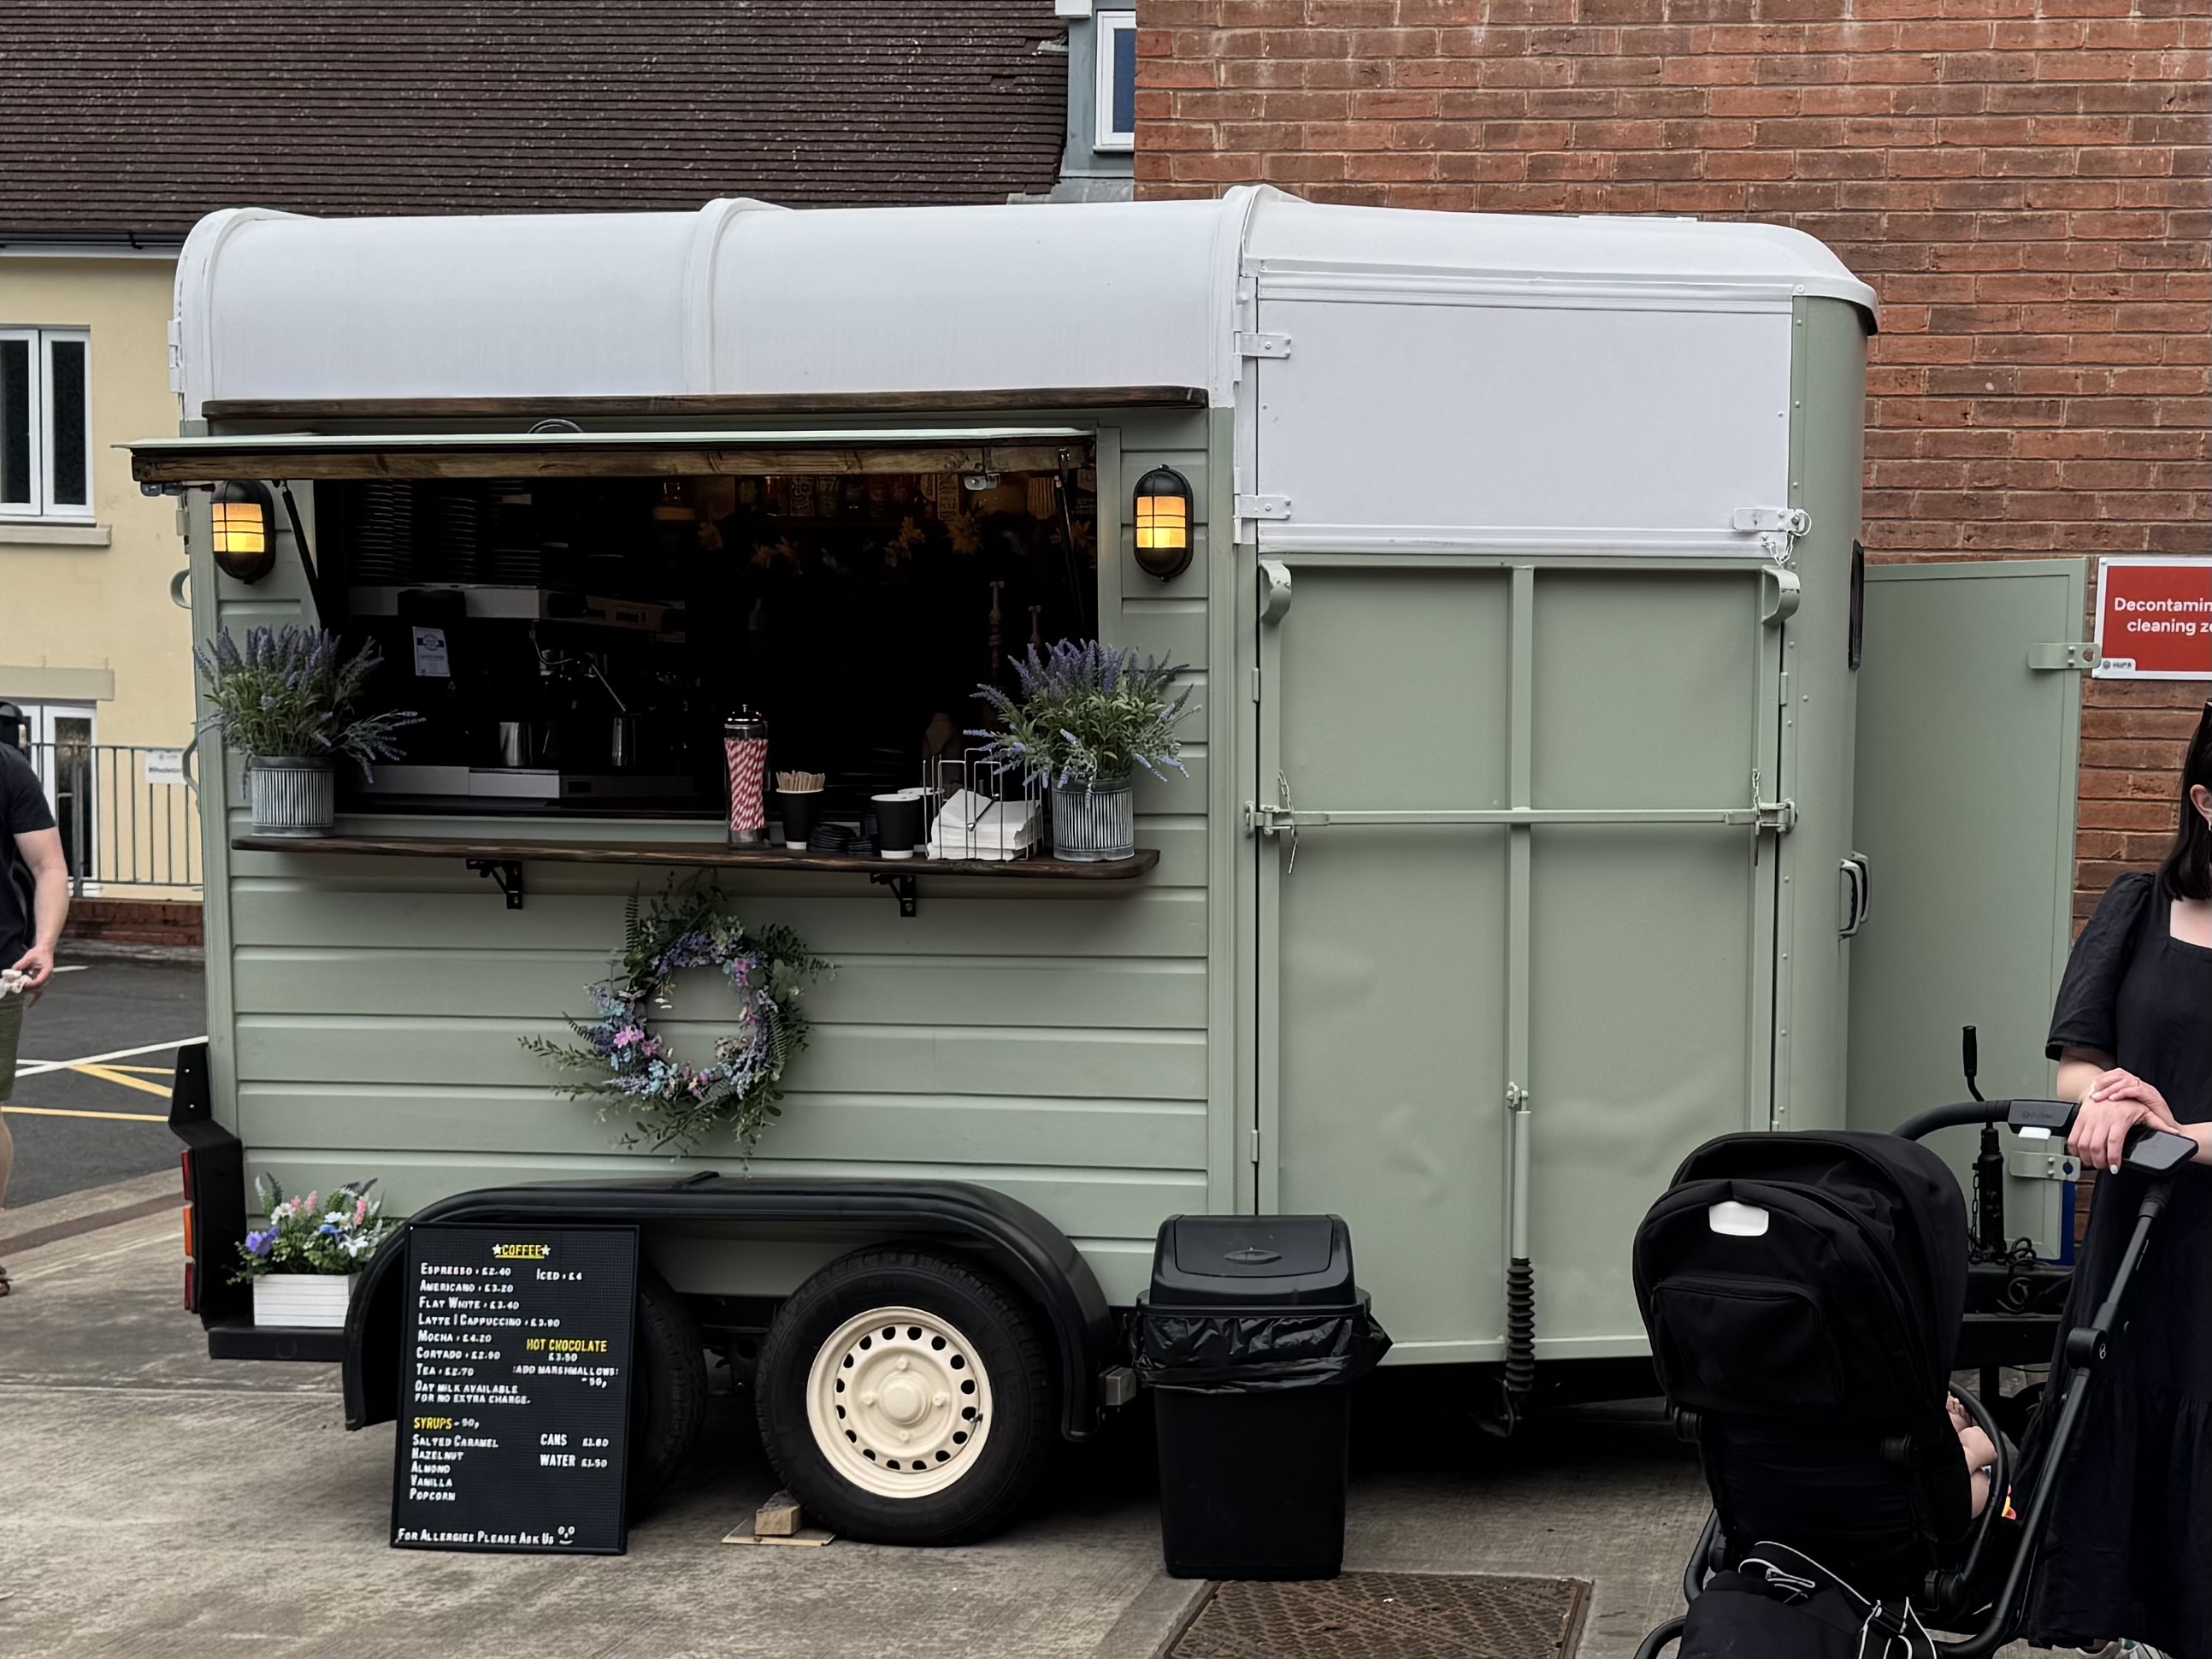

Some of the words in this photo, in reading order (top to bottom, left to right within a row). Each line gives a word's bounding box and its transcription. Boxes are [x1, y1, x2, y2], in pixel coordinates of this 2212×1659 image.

[2126, 618, 2197, 636] cleaning
[501, 1244, 542, 1256] COFFEE
[419, 1296, 445, 1309] FLAT
[417, 1330, 453, 1343] MOCHA
[526, 1338, 546, 1351] HOT
[549, 1339, 608, 1352] CHOCOLATE
[416, 1363, 437, 1376] TEA
[437, 1383, 461, 1393] MILK
[463, 1384, 518, 1395] AVAILABLE
[415, 1393, 434, 1403] FOR
[437, 1394, 451, 1403] NO
[453, 1394, 486, 1403] EXTRA
[414, 1417, 453, 1430] SYRUPS
[412, 1434, 451, 1447] SALTED
[540, 1434, 568, 1446] CANS
[411, 1448, 464, 1461] HAZELNUT
[540, 1455, 575, 1467] WATER
[410, 1461, 451, 1473] ALMOND
[410, 1474, 453, 1487] VANILLA
[410, 1488, 456, 1501] POPCORN
[398, 1528, 418, 1542] FOR
[421, 1529, 475, 1543] ALLERGIES
[477, 1530, 516, 1544] PLEASE
[519, 1532, 540, 1544] ASK
[541, 1532, 554, 1544] US
